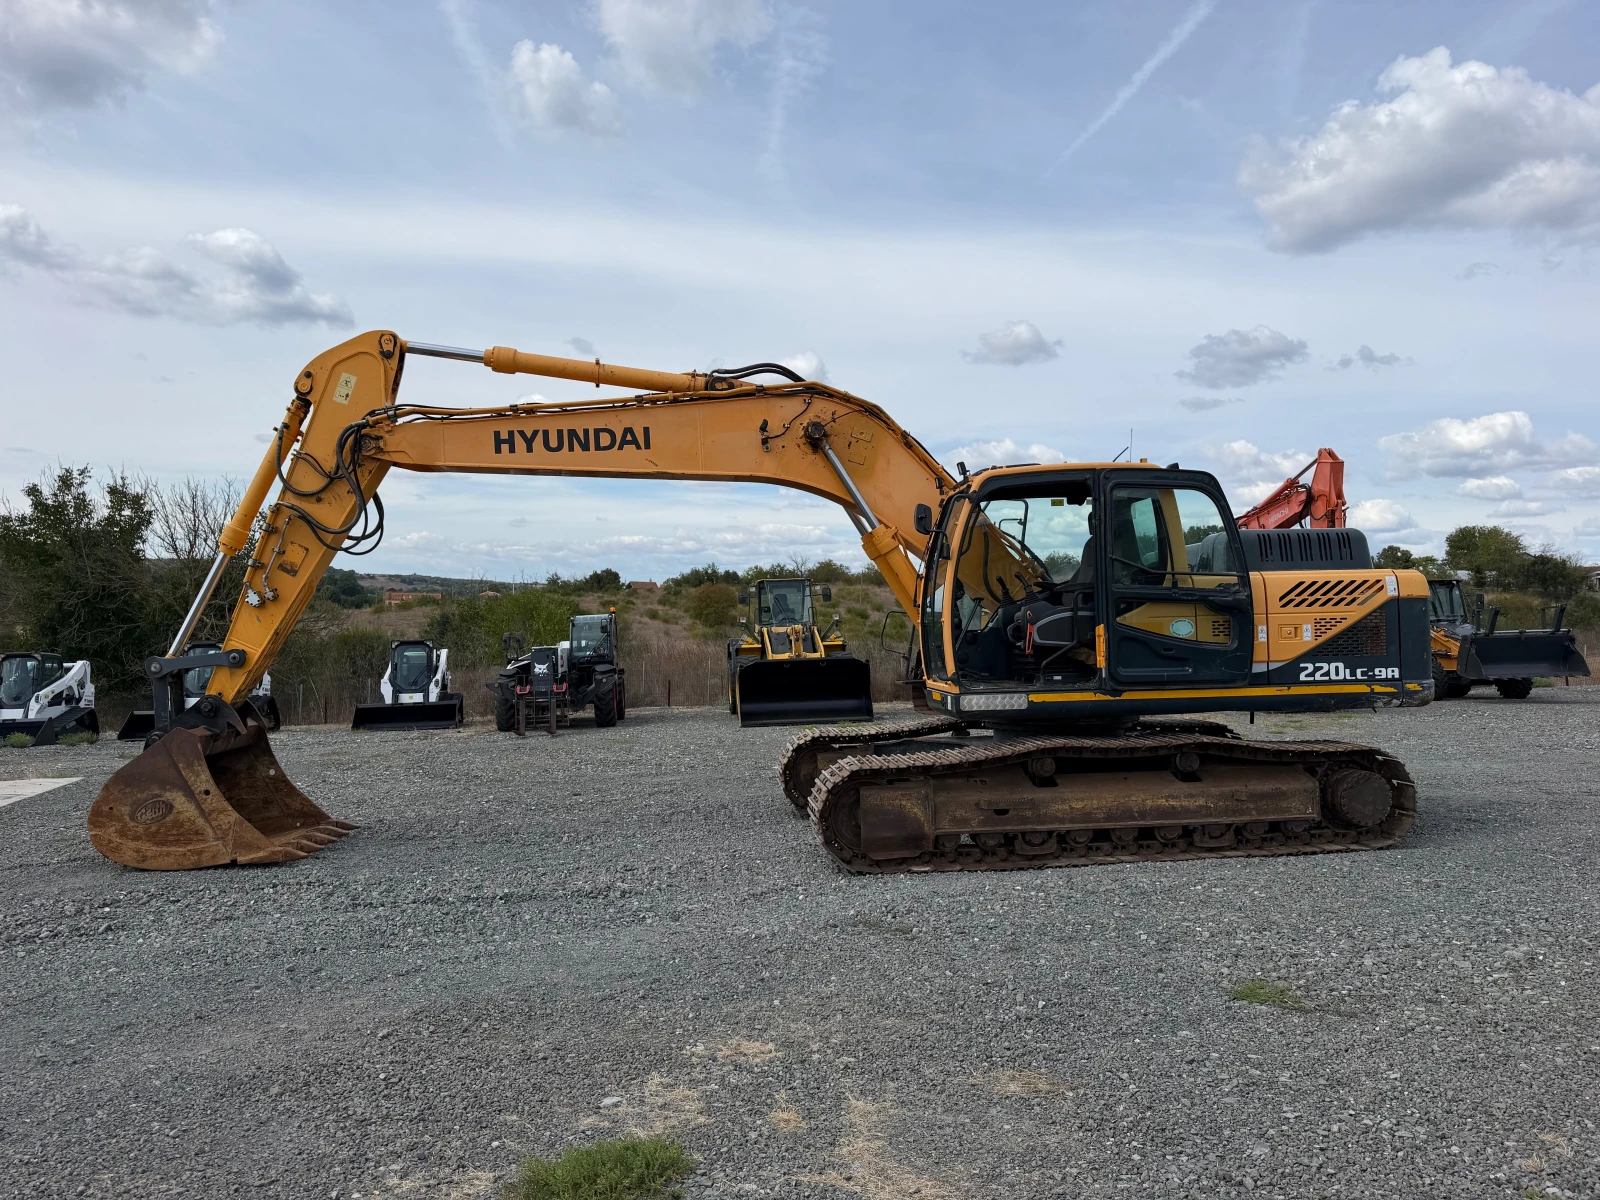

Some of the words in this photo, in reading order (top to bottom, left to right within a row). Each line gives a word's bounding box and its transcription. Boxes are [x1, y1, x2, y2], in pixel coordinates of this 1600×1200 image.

[493, 426, 651, 454] HYUNDAI
[1268, 507, 1289, 524] HITACHI
[1299, 662, 1400, 681] 220LC-9A
